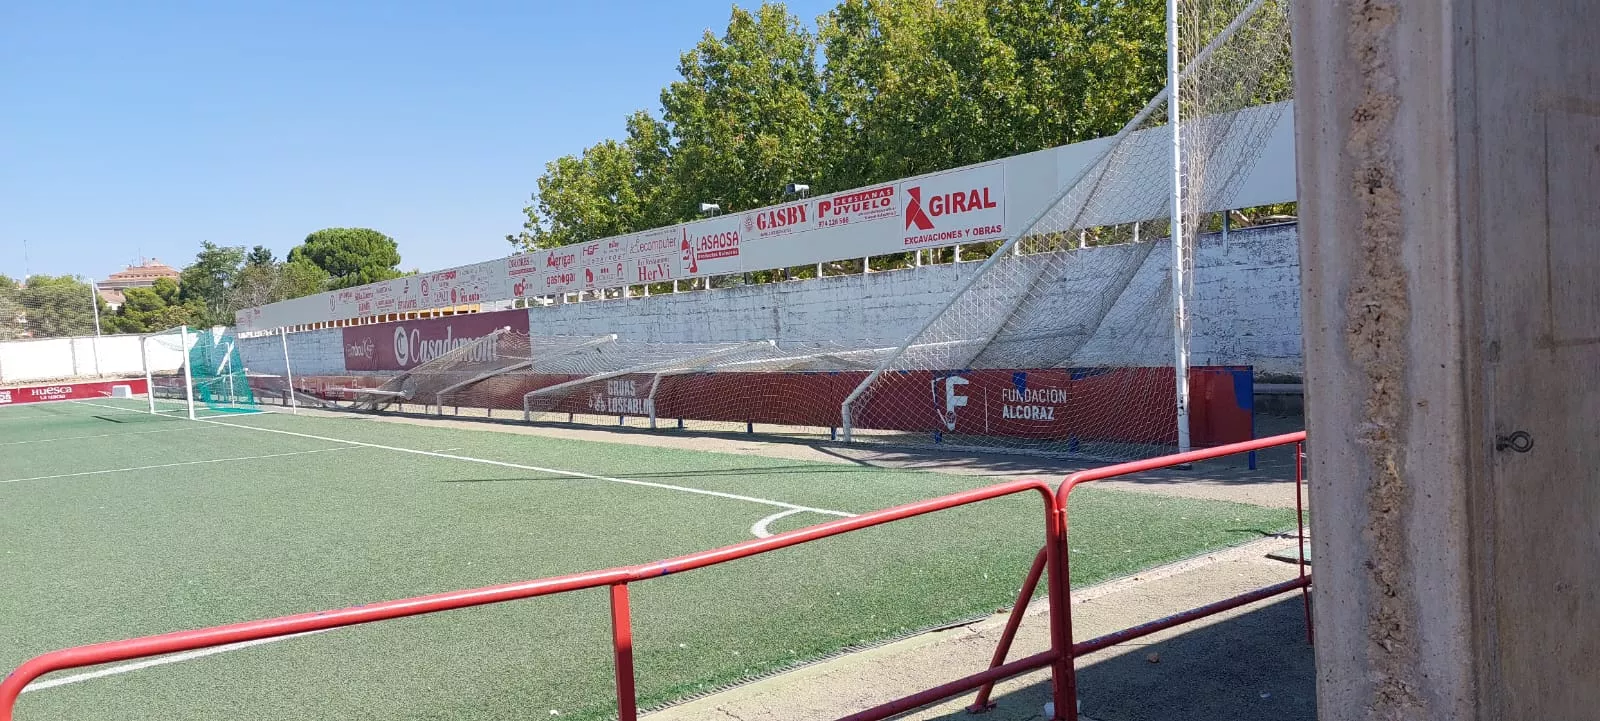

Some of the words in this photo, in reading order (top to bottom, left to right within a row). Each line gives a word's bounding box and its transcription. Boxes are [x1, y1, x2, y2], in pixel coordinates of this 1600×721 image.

[835, 188, 892, 205] PERSIANAS
[929, 187, 996, 217] GIRAL
[756, 204, 808, 231] GASBY
[818, 197, 891, 218] PUYUELO
[696, 231, 739, 251] LASAOSA
[904, 230, 962, 245] EXCAVACIONES
[965, 228, 970, 237] Y
[973, 224, 1002, 236] OBRAS
[638, 264, 670, 281] HerVi
[410, 326, 500, 364] Casademont
[31, 386, 72, 396] Huesca
[608, 380, 636, 396] GRUAS
[1002, 405, 1055, 420] ALCORAZ
